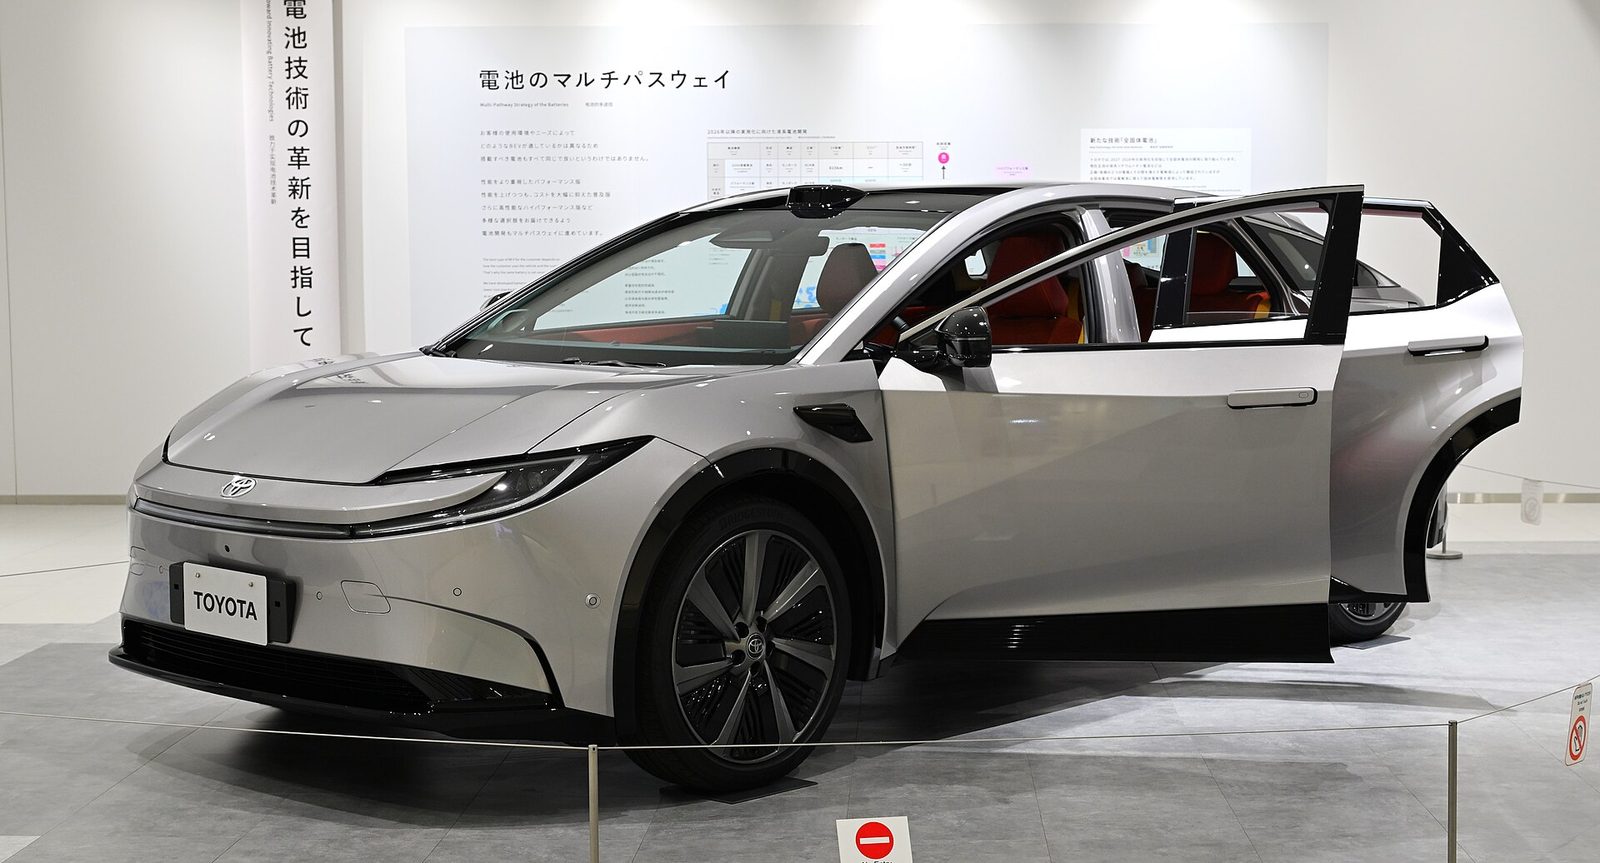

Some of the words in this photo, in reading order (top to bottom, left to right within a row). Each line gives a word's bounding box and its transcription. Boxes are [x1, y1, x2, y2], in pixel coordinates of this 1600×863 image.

[479, 69, 730, 90] 電池のマルチパスウェイ
[284, 0, 313, 346] 電池技術の革新を目指して
[193, 590, 258, 621] TOYOTA
